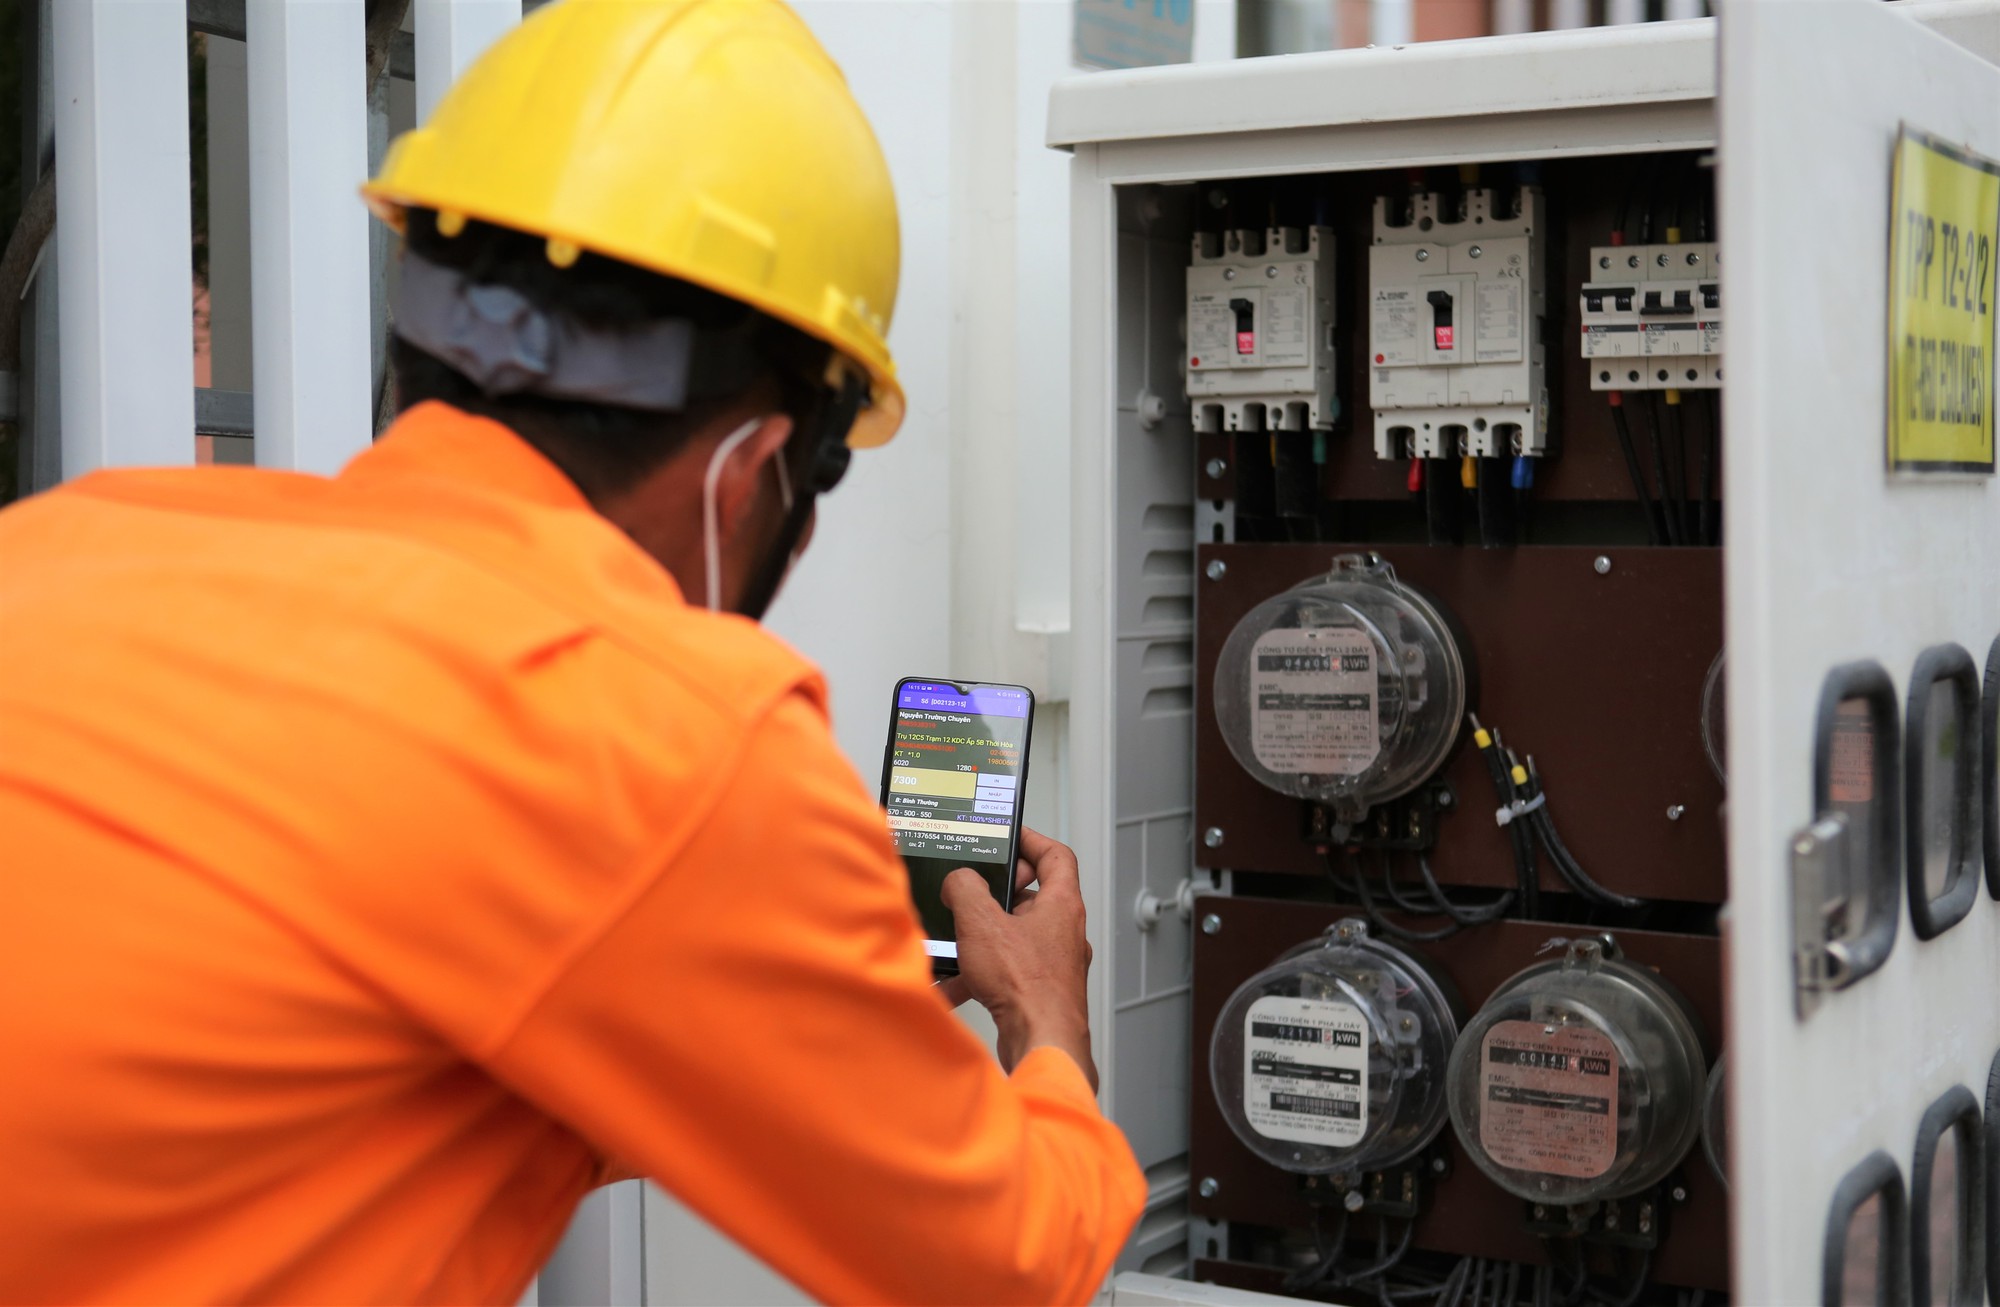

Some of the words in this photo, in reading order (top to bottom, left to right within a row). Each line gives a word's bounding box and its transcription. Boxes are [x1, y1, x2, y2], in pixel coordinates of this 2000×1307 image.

[1906, 209, 1934, 300] TPP
[1942, 222, 1988, 321] T2-2/2
[1438, 327, 1450, 336] ON
[896, 733, 907, 741] Trụ
[926, 735, 942, 743] Trạm
[893, 775, 917, 785] 7300
[1252, 1013, 1275, 1022] CÔNG
[1336, 1032, 1358, 1044] kWh
[1584, 1060, 1606, 1072] kWh
